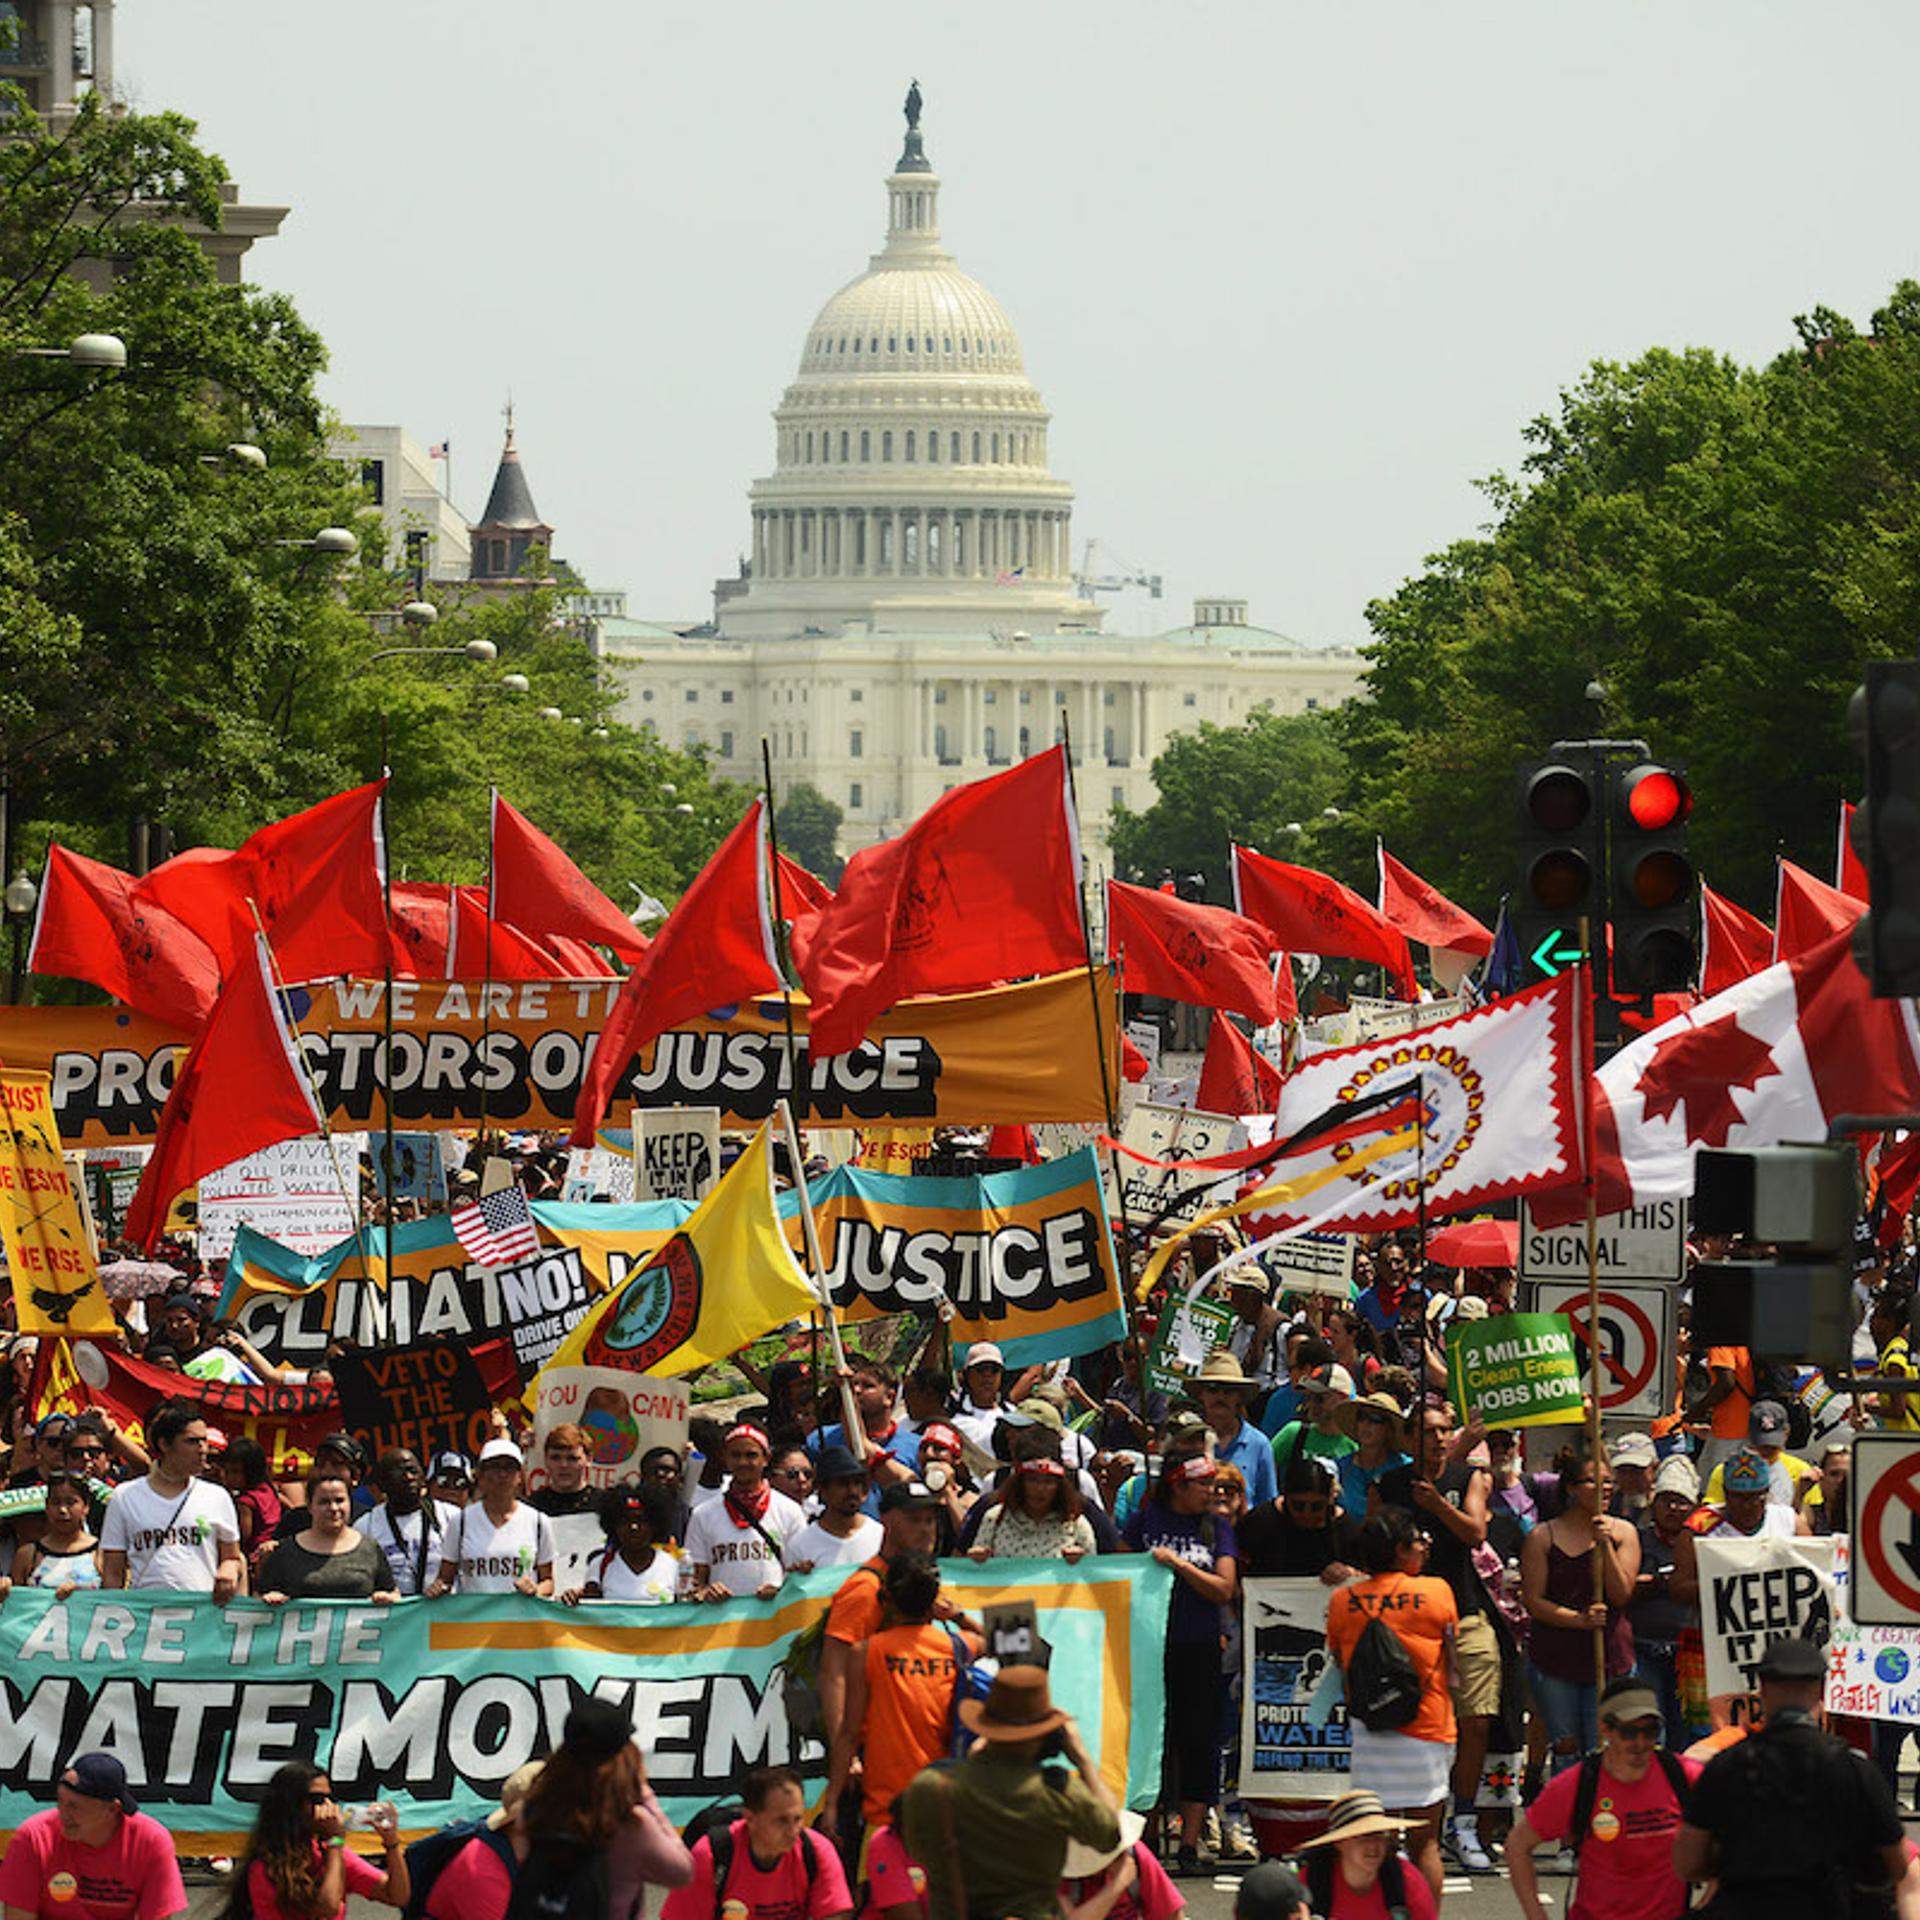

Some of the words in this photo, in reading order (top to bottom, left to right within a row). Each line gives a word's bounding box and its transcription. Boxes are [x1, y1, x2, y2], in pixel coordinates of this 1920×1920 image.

[335, 982, 420, 1020] WE
[435, 982, 551, 1020] ARE
[631, 1033, 923, 1092] JUSTICE
[645, 1132, 704, 1169] KEEP
[240, 1164, 269, 1179] OIL
[650, 1169, 666, 1186] IT
[671, 1168, 687, 1184] IN
[811, 1212, 1092, 1302] JUSTICE
[1529, 1235, 1627, 1266] SIGNAL
[238, 1252, 545, 1351] CLIMAT
[499, 1252, 586, 1323] NO!
[513, 1316, 563, 1348] DRIVE
[362, 1348, 459, 1387] VETO
[1466, 1349, 1481, 1369] 2
[1485, 1333, 1570, 1364] MILLION
[1467, 1365, 1520, 1388] Clean
[1471, 1384, 1531, 1411] JOBS
[1534, 1377, 1580, 1400] NOW
[381, 1380, 453, 1421] THE
[539, 1384, 578, 1408] YOU
[1348, 1592, 1426, 1613] STAFF
[1712, 1566, 1818, 1636] KEEP
[16, 1604, 196, 1663] ARE
[224, 1607, 391, 1666] THE
[1726, 1634, 1758, 1663] IT
